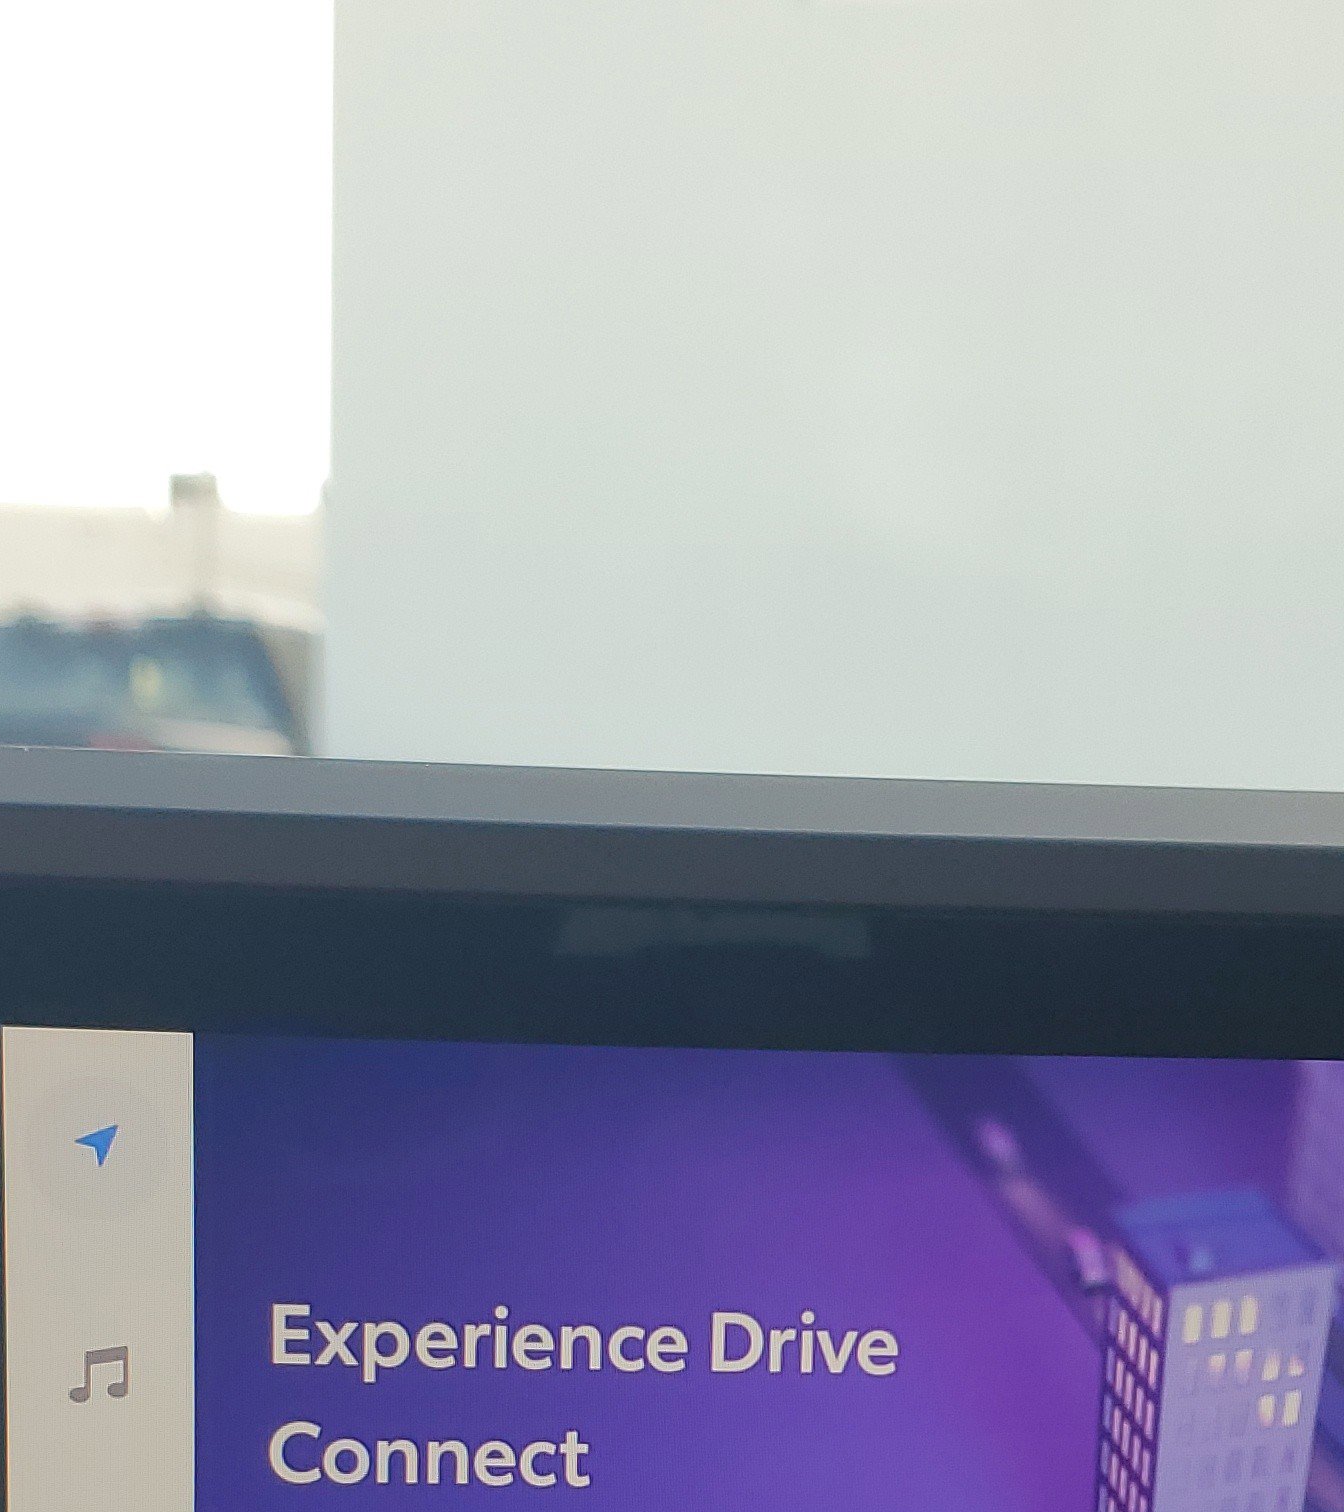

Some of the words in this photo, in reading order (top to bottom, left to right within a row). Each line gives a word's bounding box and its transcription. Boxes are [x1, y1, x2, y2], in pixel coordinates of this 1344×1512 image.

[269, 1303, 688, 1383] Experience
[709, 1310, 899, 1376] Drive
[269, 1420, 591, 1489] Connect
